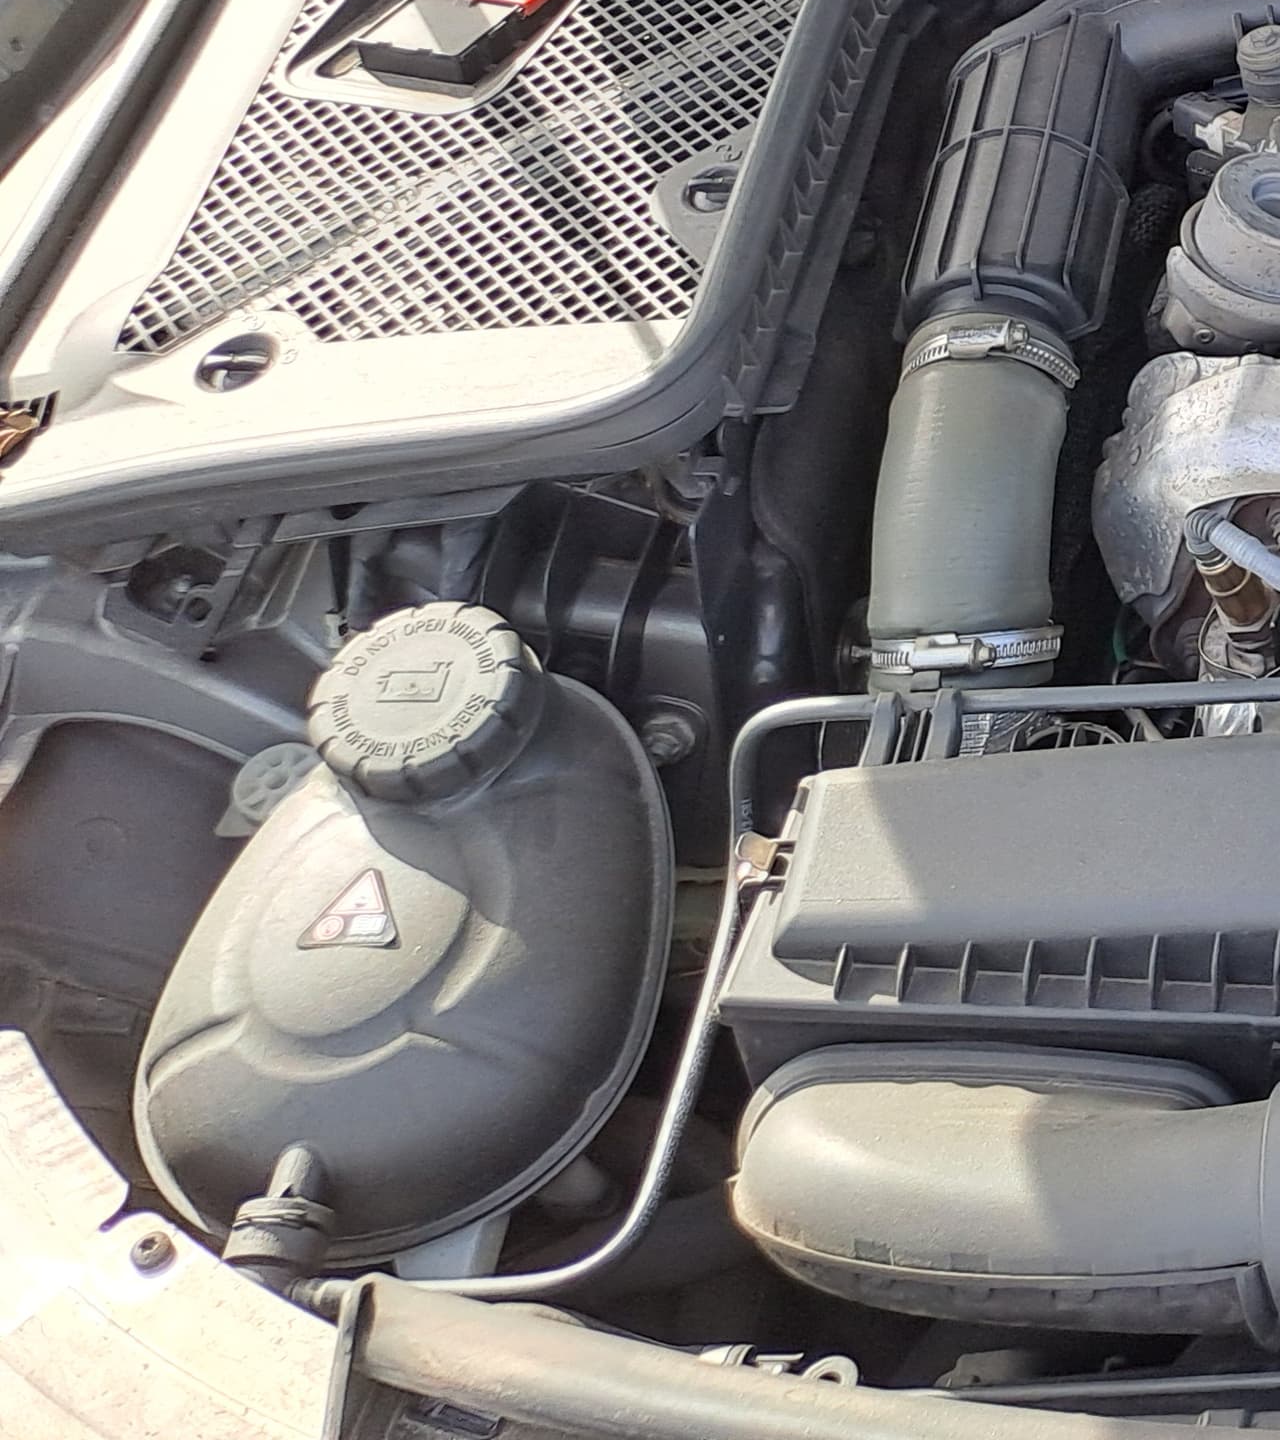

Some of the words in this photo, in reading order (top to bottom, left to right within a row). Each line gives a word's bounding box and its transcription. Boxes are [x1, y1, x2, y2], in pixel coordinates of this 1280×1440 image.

[344, 655, 368, 676] DO
[366, 629, 397, 655] NOT
[403, 618, 447, 636] OPEN
[448, 619, 487, 650] WHEN
[475, 647, 496, 674] HOT
[331, 693, 354, 732] NICHT
[402, 728, 448, 755] WENN
[448, 693, 486, 732] HEISS
